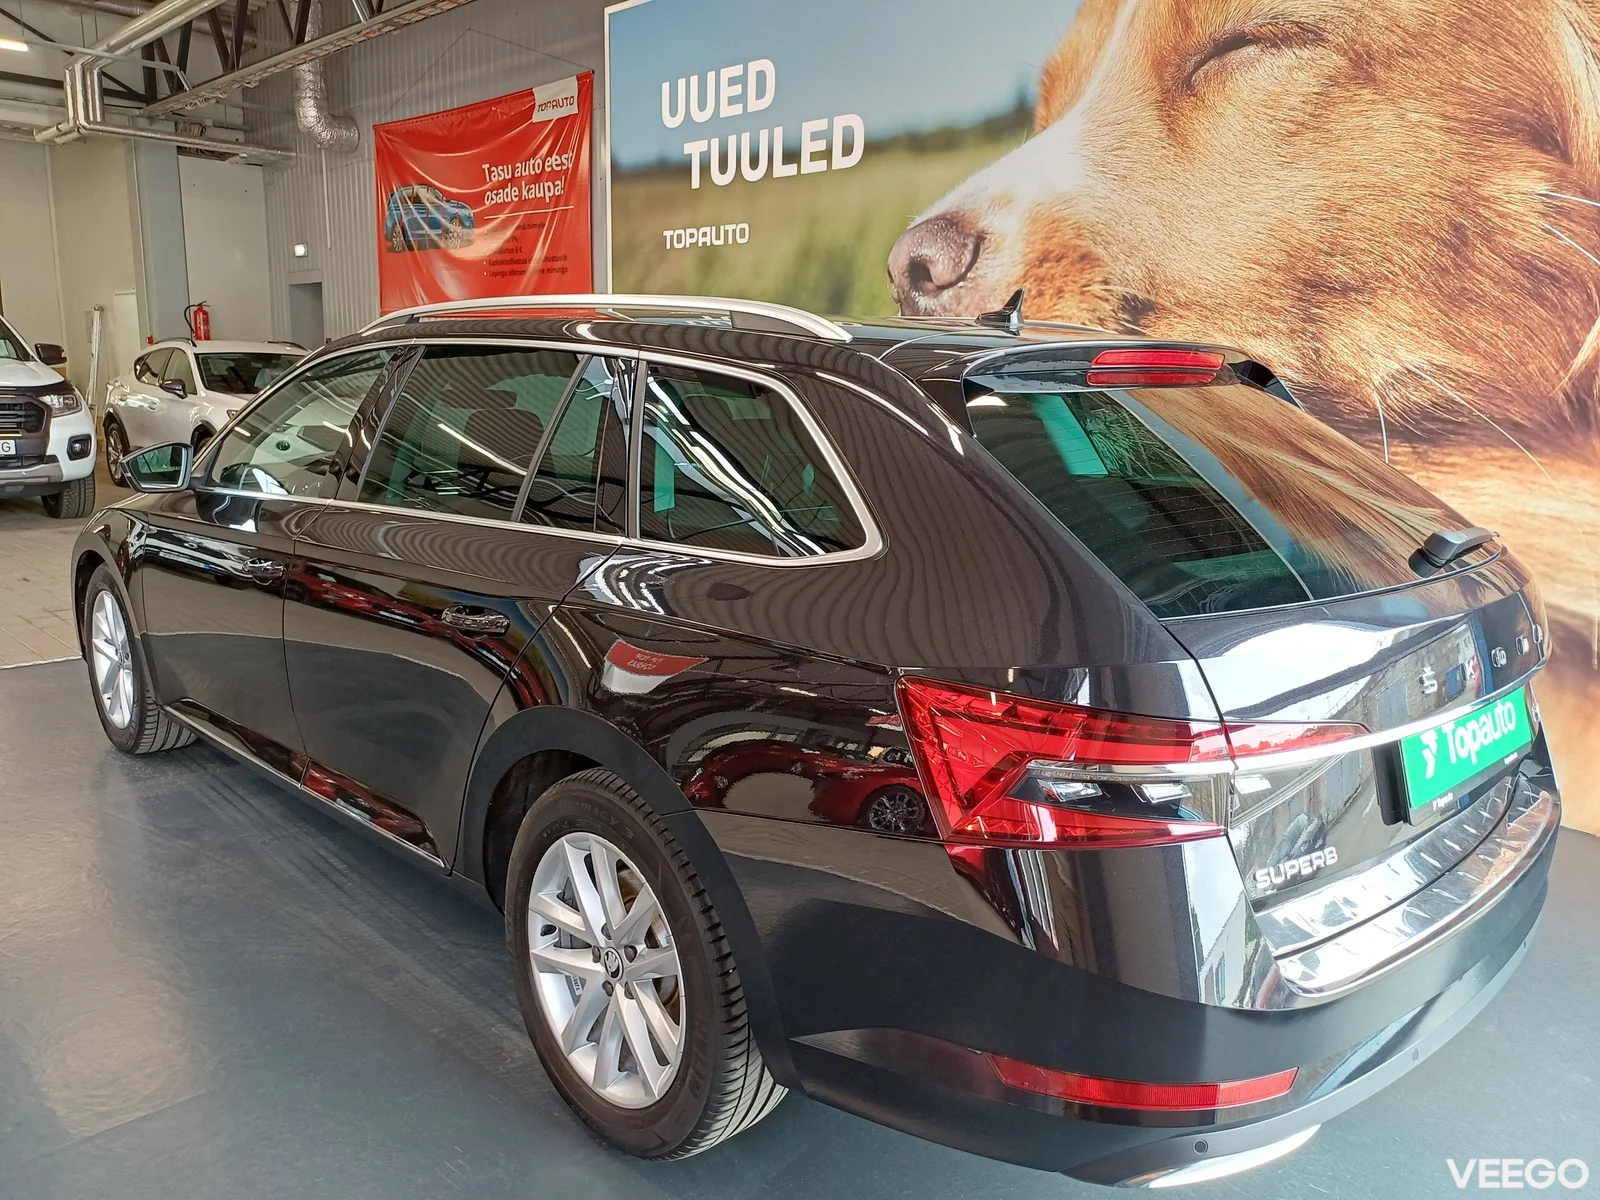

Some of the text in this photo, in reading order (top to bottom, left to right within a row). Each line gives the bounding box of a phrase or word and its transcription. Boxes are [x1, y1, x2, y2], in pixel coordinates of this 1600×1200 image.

[537, 95, 575, 113] TOPAUTO
[661, 58, 776, 129] UUED
[482, 152, 573, 182] Tasu auto eest
[683, 113, 865, 190] TUULED
[484, 175, 565, 205] osade kaupa!
[662, 222, 750, 250] TOPAUTO
[1441, 700, 1517, 765] Topauto
[1254, 846, 1339, 890] SUPERB
